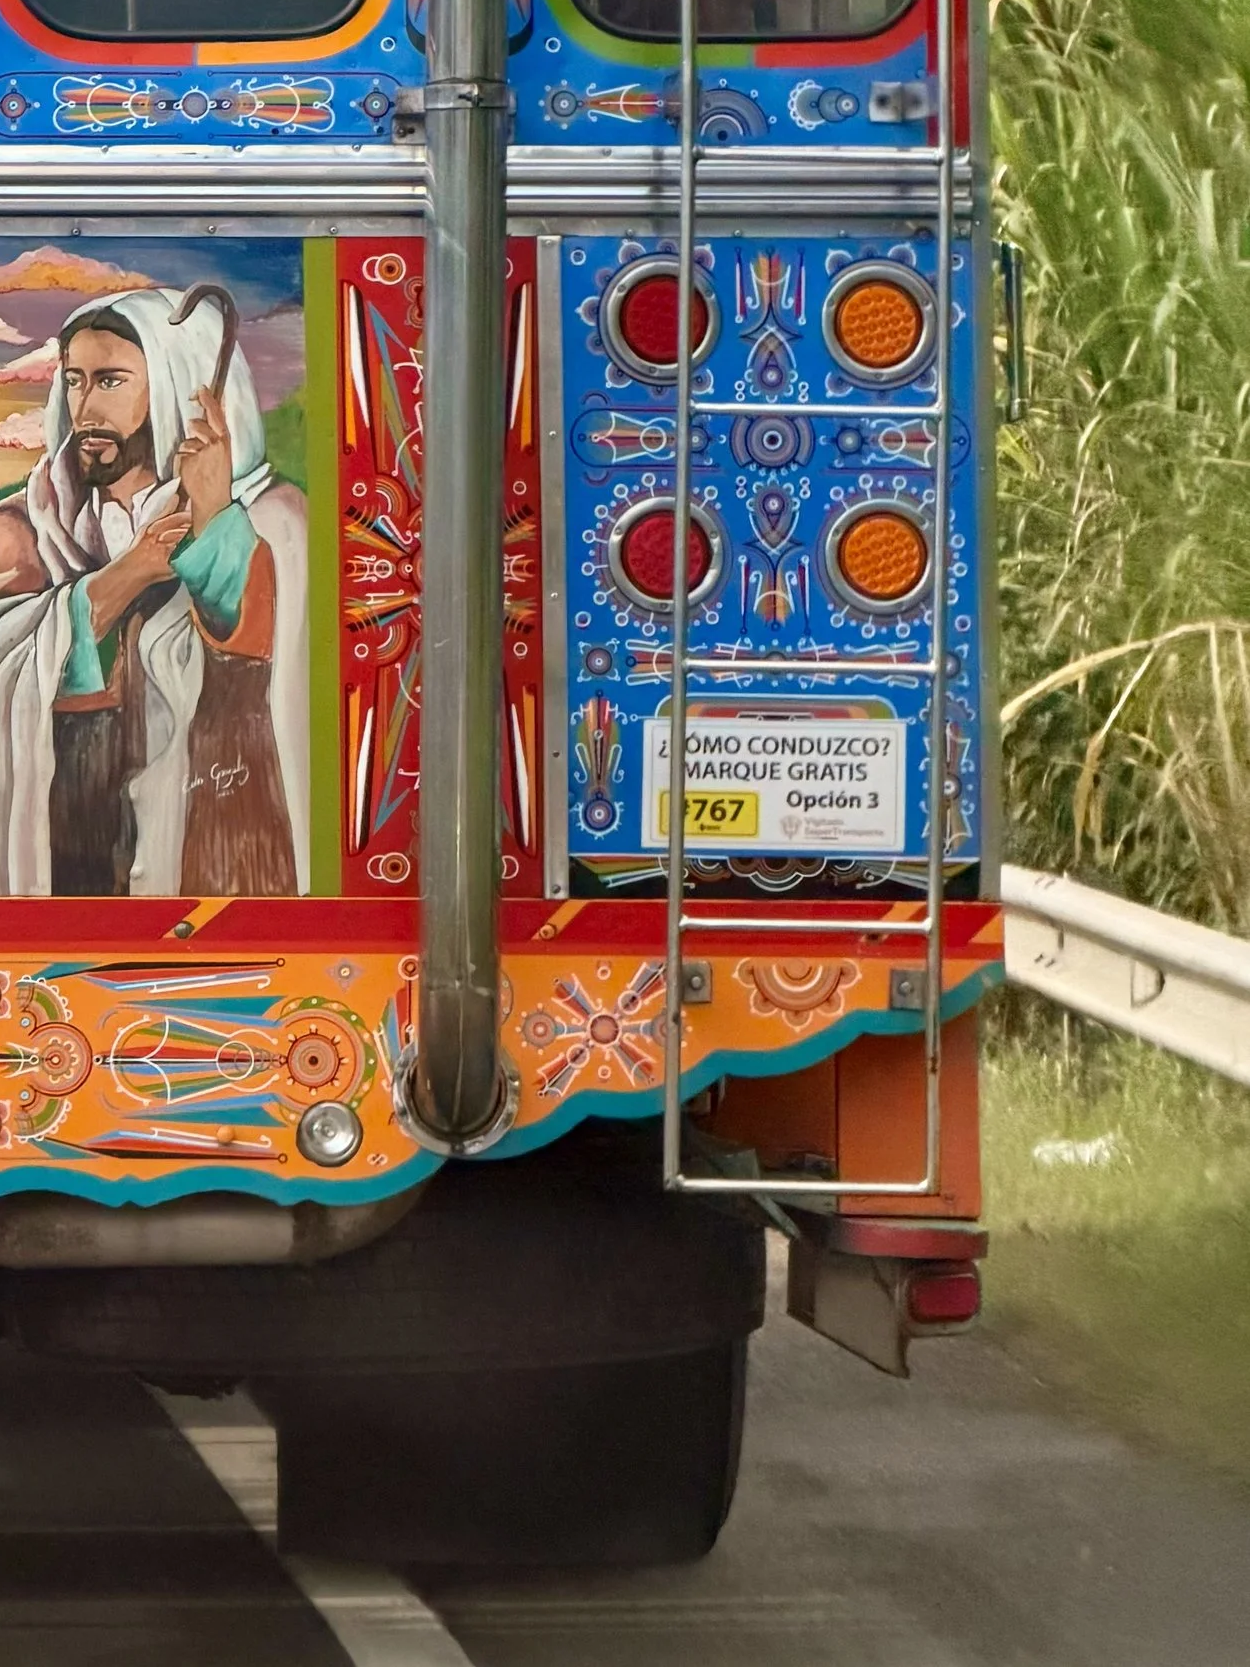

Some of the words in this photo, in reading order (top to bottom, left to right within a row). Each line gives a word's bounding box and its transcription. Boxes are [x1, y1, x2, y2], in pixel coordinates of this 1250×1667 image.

[658, 732, 741, 758] ¿ÓMO
[747, 736, 891, 757] CONDUZCO?
[684, 761, 782, 782] MARQUE
[788, 762, 868, 782] GRATIS
[786, 790, 861, 812] Opción
[867, 792, 880, 809] 3
